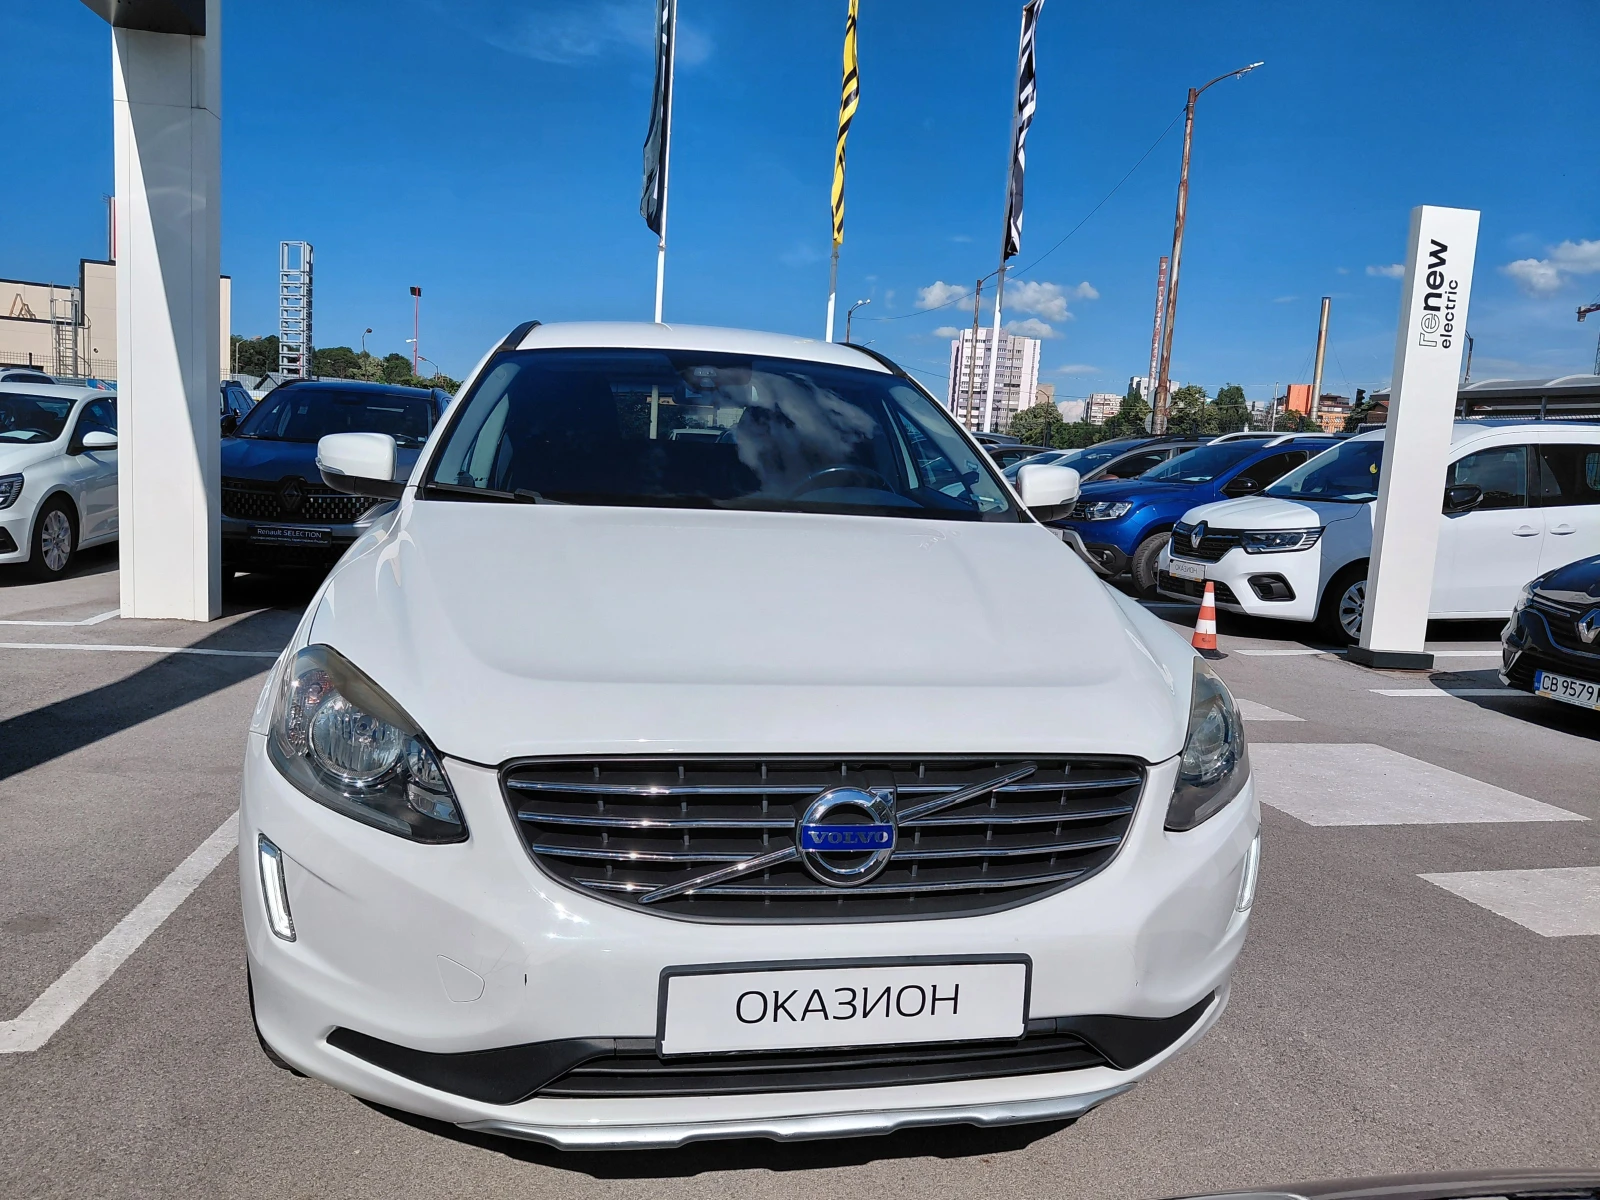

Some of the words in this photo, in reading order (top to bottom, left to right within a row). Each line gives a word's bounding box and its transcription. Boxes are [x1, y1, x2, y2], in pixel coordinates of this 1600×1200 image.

[1418, 238, 1449, 348] renew
[1440, 279, 1459, 349] electric
[257, 528, 282, 536] Renault
[283, 529, 322, 538] SELECTION
[1561, 679, 1595, 701] 9579
[807, 831, 889, 844] VOLVO
[735, 983, 960, 1024] ОКАЗИОН
